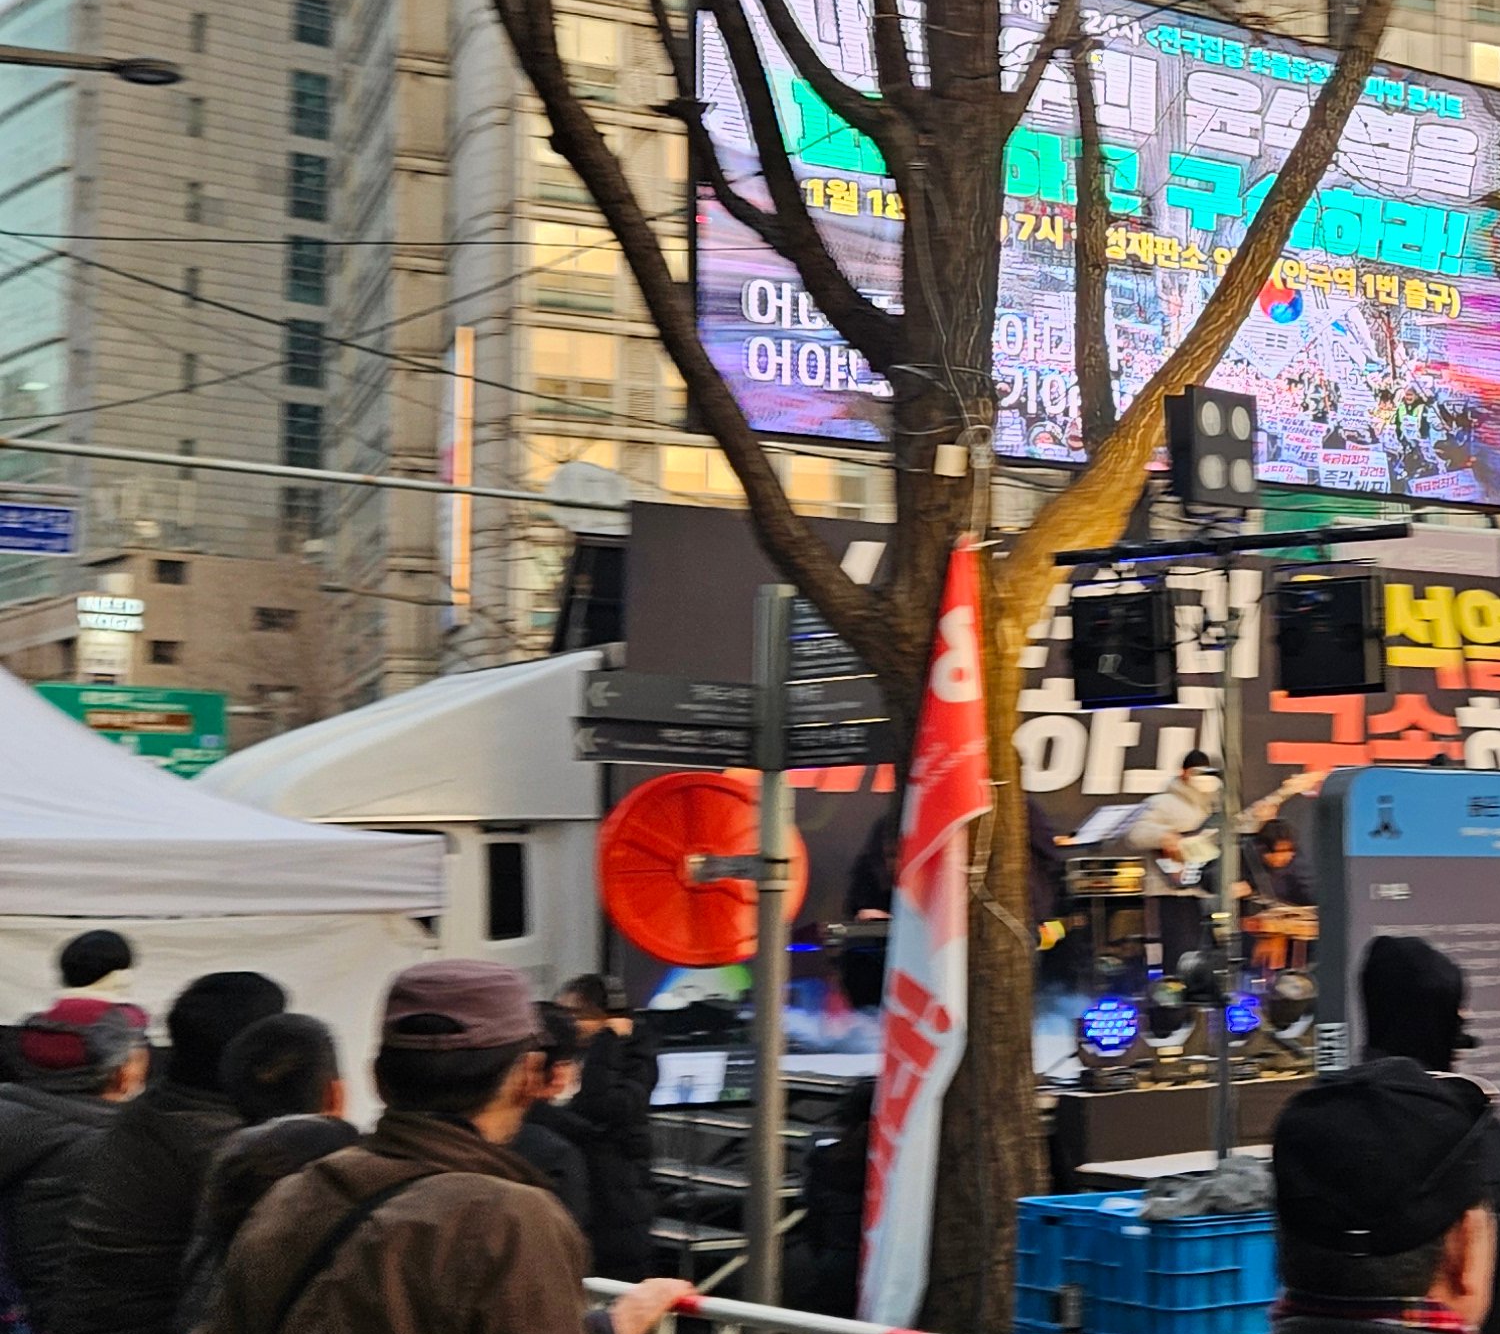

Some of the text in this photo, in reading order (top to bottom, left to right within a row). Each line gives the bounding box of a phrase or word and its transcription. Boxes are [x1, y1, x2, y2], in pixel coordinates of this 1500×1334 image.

[801, 177, 859, 216] 1월
[1016, 213, 1067, 250] 7시
[1272, 257, 1358, 299] (안국역
[1361, 273, 1399, 306] 1번
[1402, 278, 1462, 320] 출구)
